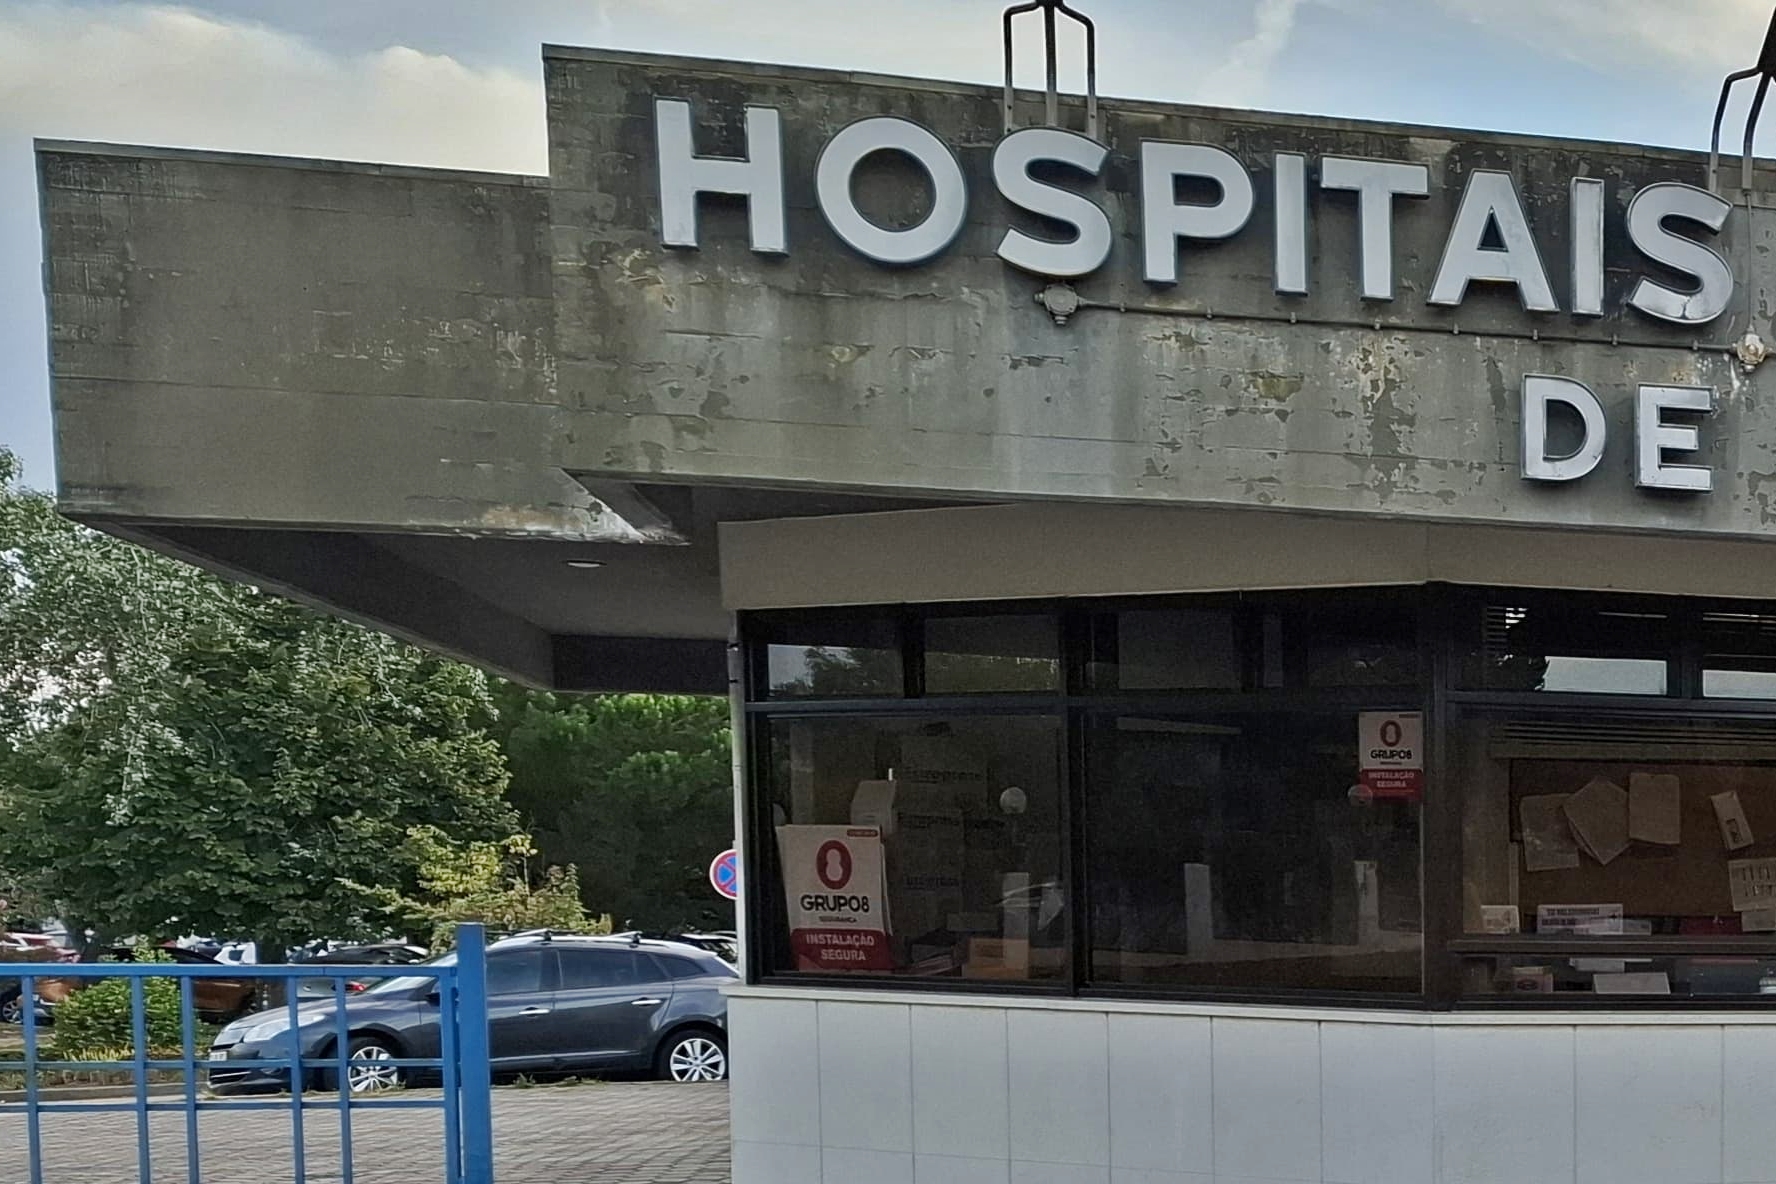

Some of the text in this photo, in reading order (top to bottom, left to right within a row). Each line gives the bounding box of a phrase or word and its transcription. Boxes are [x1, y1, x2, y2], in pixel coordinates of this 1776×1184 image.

[652, 96, 1735, 325] HOSPITAIS
[1519, 373, 1714, 492] DE
[801, 894, 870, 912] GRUPO8
[806, 933, 875, 947] INSTALAÇÃO
[820, 948, 867, 961] SEGURA
